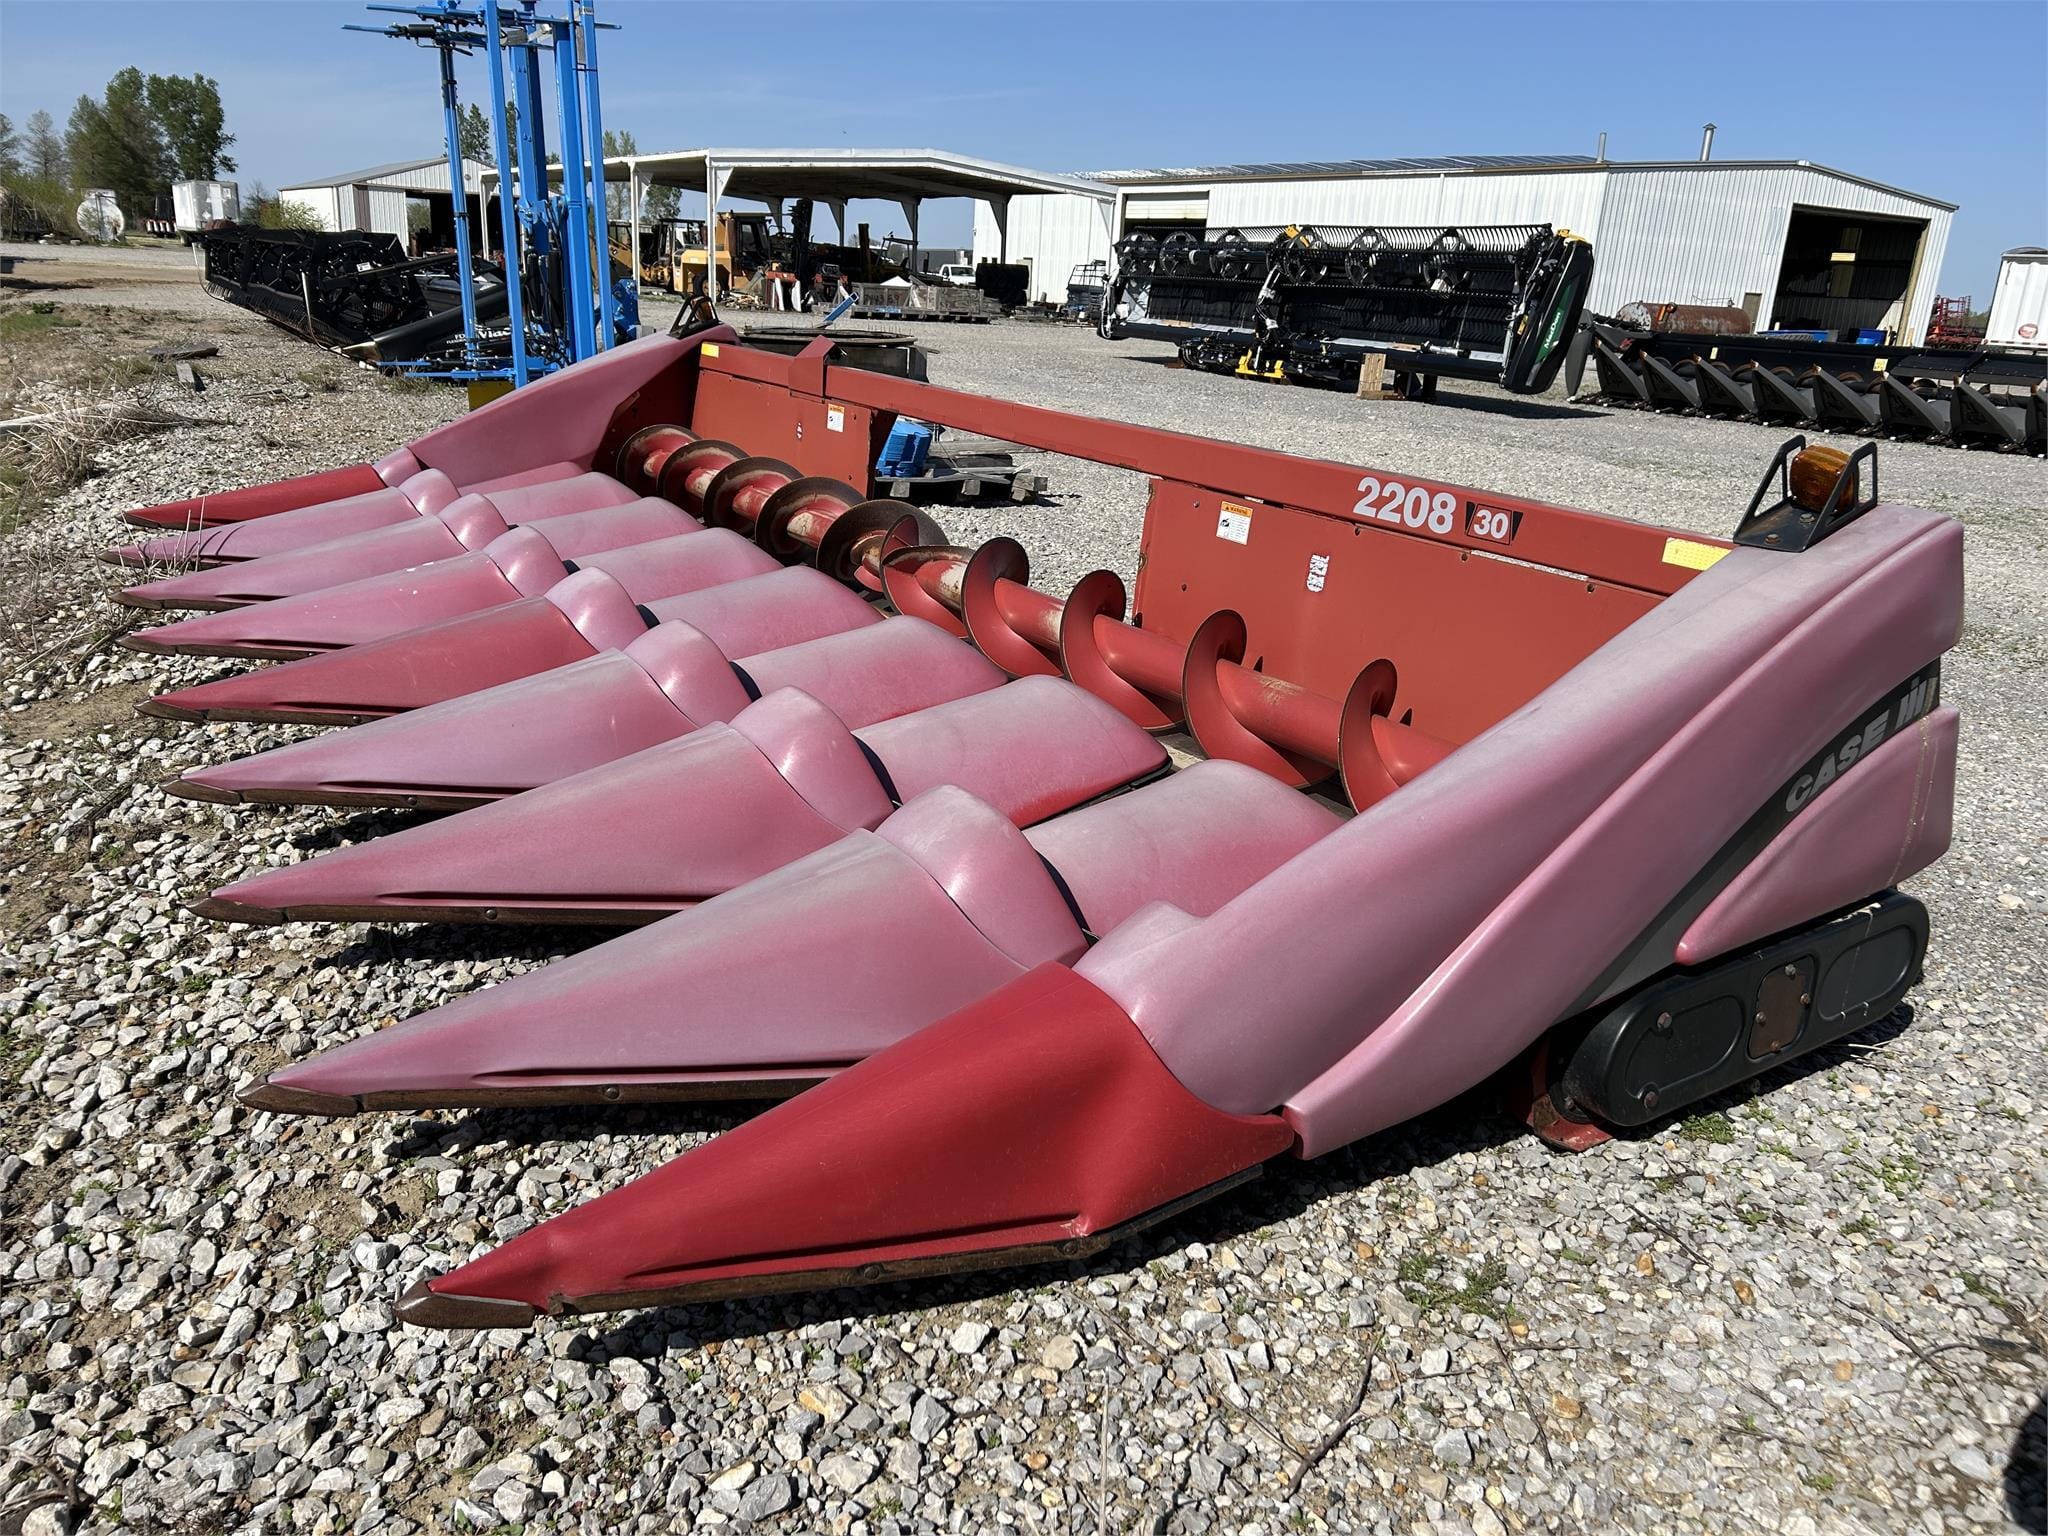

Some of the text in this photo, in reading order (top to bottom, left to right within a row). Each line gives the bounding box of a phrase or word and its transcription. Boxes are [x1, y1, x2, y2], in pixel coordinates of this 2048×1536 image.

[1353, 477, 1509, 539] 2208 30
[1785, 709, 1890, 812] CASE
